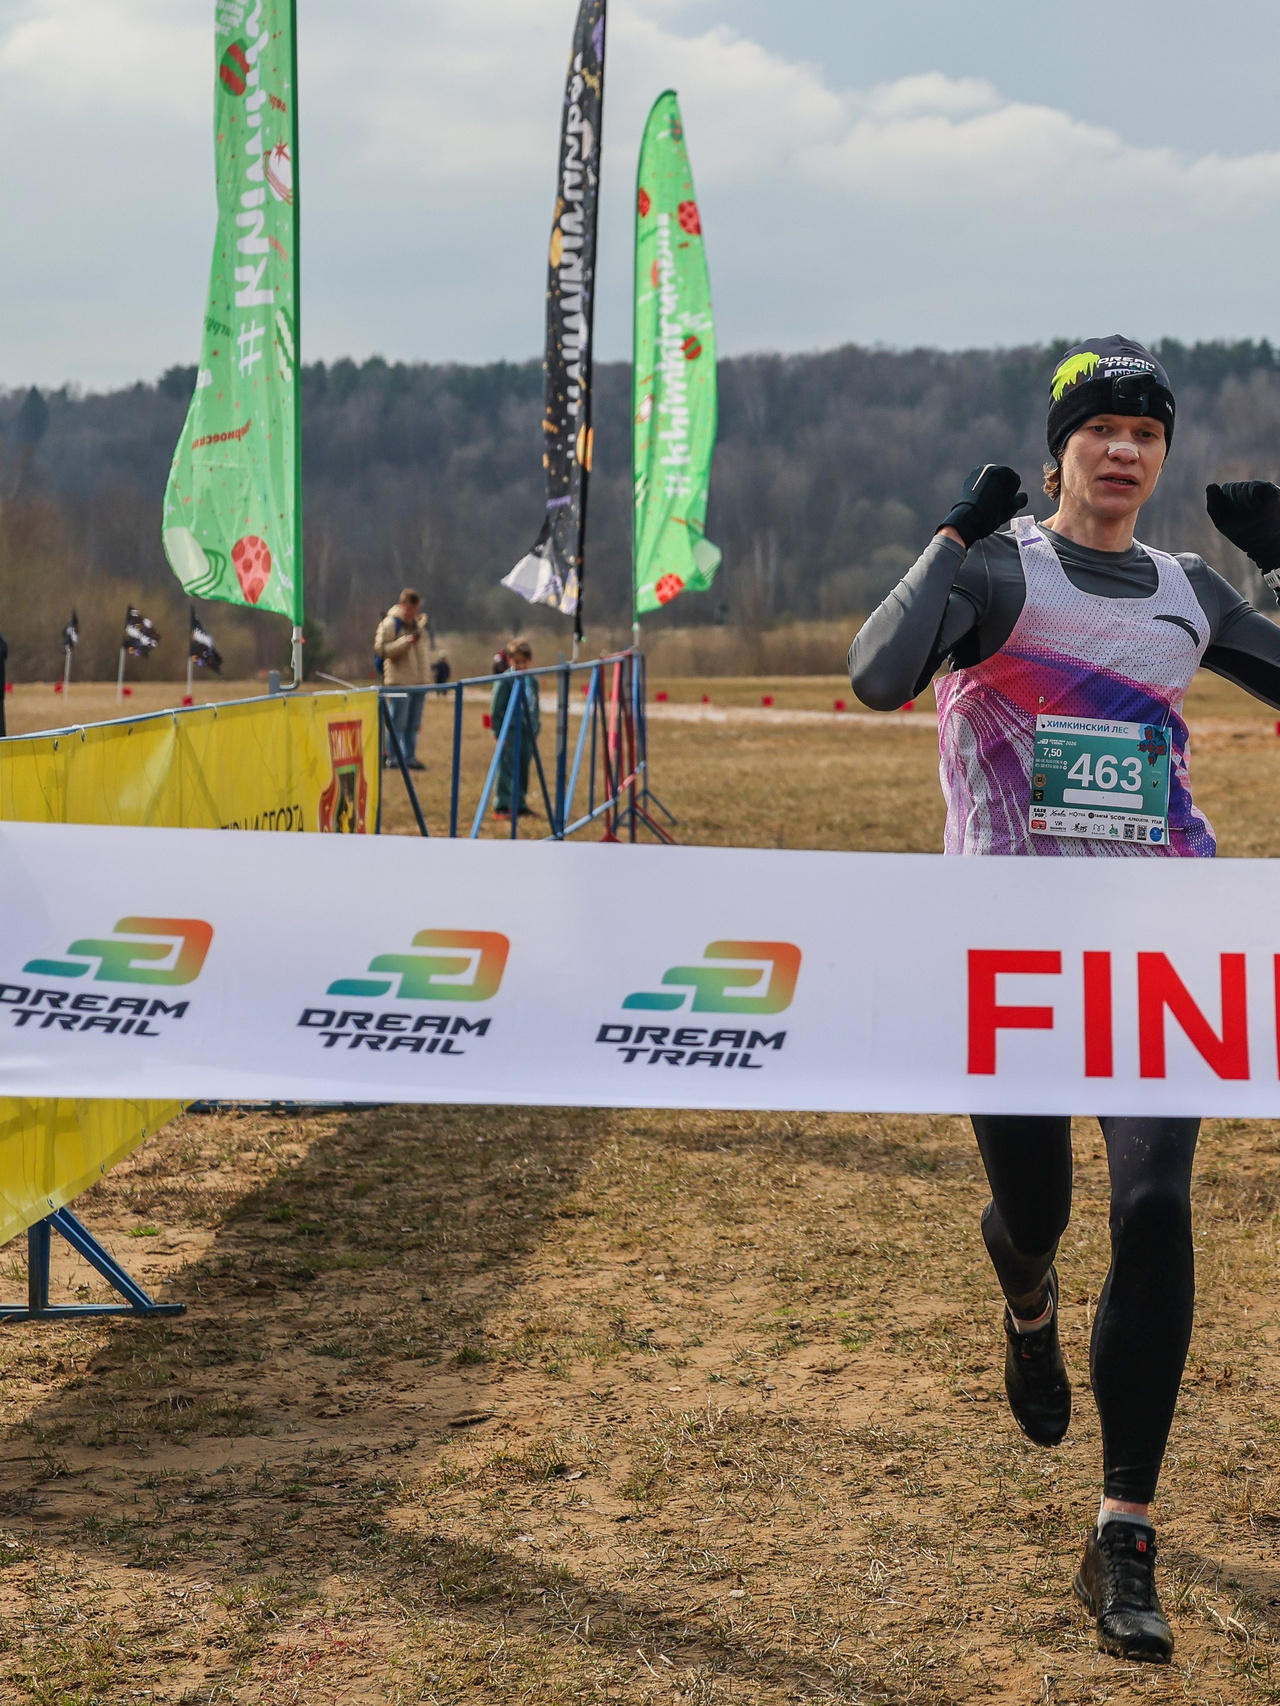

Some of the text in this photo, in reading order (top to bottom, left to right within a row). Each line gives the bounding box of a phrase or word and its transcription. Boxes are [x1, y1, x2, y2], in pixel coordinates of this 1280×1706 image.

[1046, 720, 1129, 734] ХИМКИНСКИЙ ЛЕС
[1043, 747, 1062, 758] 7,50
[1067, 753, 1143, 792] 463
[0, 983, 190, 1018] DREAM
[11, 1008, 160, 1036] TRAIL
[297, 1008, 493, 1036] DREAM
[319, 1031, 465, 1055] TRAIL
[595, 1024, 788, 1050] DREAM
[617, 1047, 763, 1069] TRAIL
